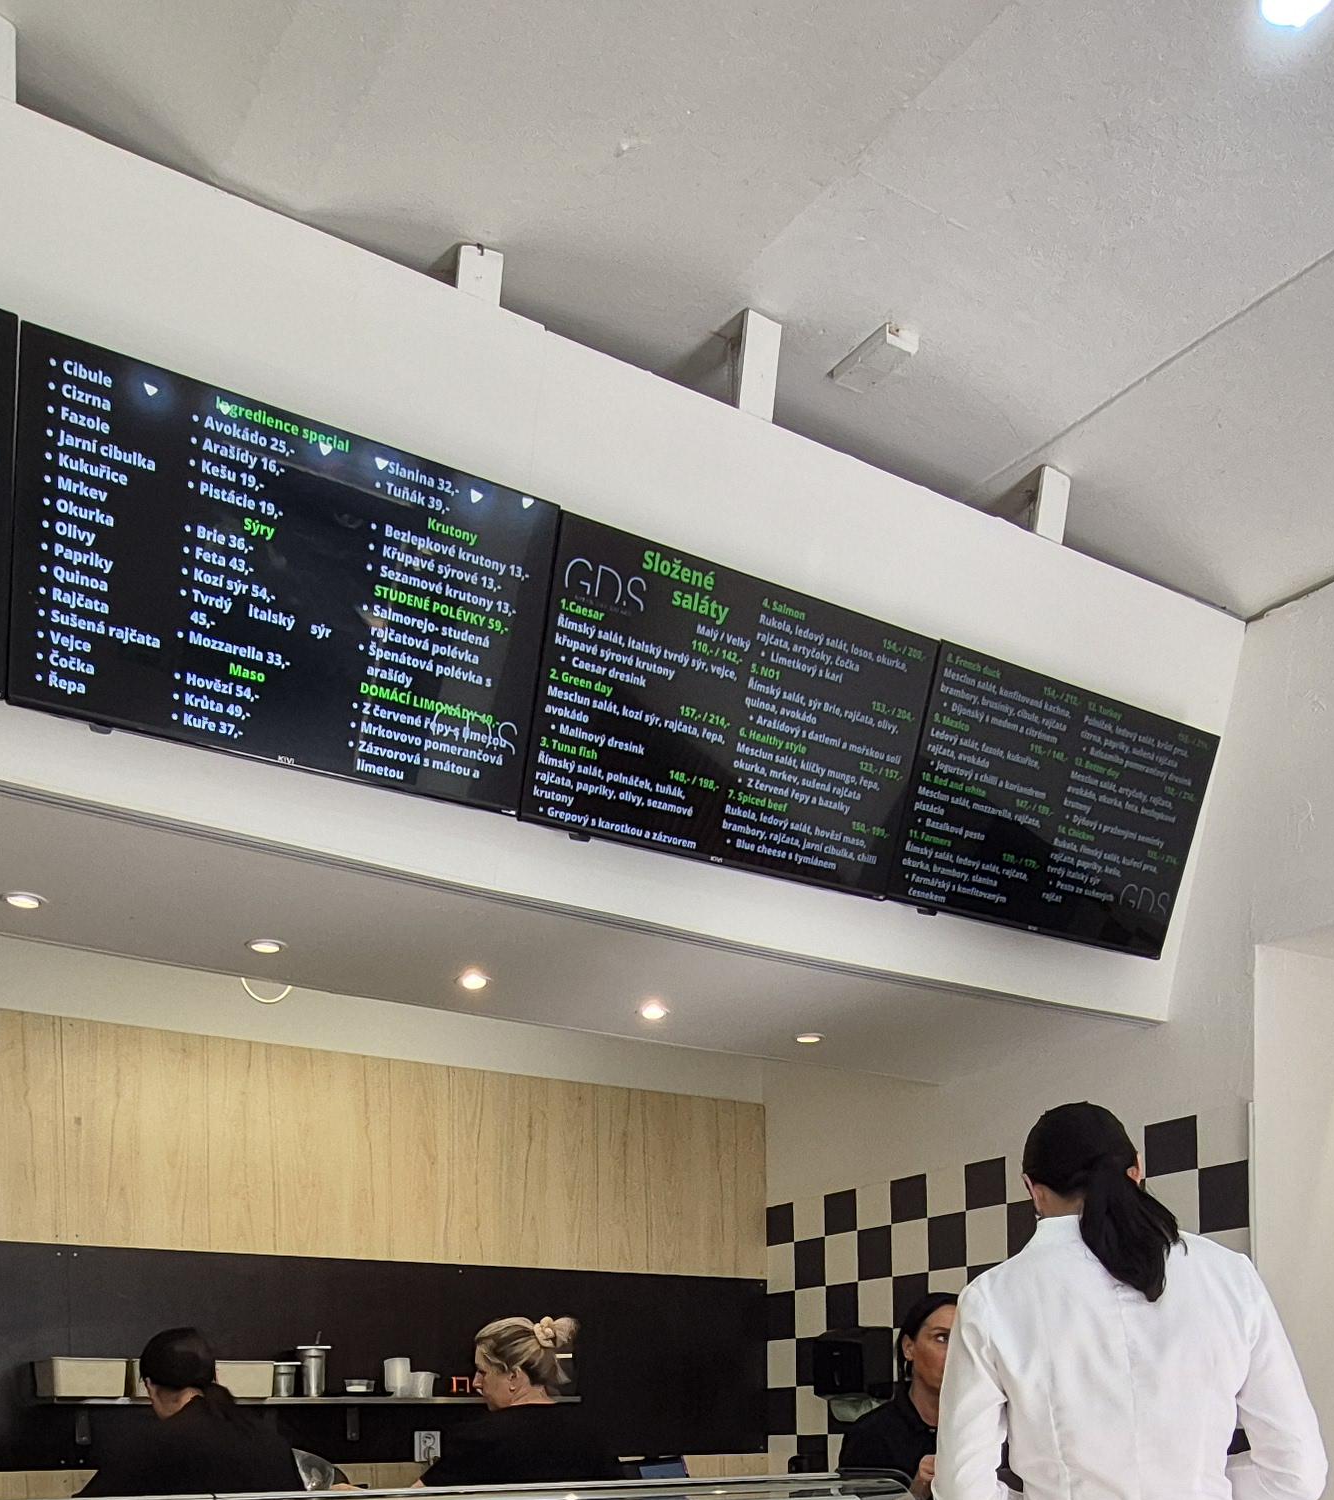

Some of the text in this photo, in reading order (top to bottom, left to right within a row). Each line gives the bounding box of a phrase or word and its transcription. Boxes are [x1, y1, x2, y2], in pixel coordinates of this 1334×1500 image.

[62, 360, 113, 388] Cibule
[61, 383, 112, 412] Cizrna
[60, 406, 111, 434] Fazole
[57, 429, 156, 472] Jarní cibulka
[203, 415, 295, 458] Avokádo 25,-
[58, 452, 128, 486] Kukuřice
[201, 437, 285, 477] Arašídy 16,-
[57, 475, 108, 502] Mrkev
[201, 458, 265, 492] Kešu 19,-
[387, 458, 460, 497] Slanina 32,-
[199, 480, 284, 520] Pistácie 19,-
[385, 480, 451, 515] Tuňák 39,-
[55, 498, 115, 528] Okurka
[55, 520, 97, 547] Olivy
[196, 524, 254, 554] Brie 36,-
[243, 517, 275, 541] Sýry
[427, 516, 478, 546] Krutony
[53, 542, 114, 574] Papriky
[195, 546, 255, 576] Feta 43,-
[52, 565, 109, 592] Quinoa
[51, 586, 109, 614] Rajčata
[373, 584, 509, 635] STUDENÉ POLÉVKY 59,-
[49, 630, 92, 653] Vejce
[50, 608, 161, 649] Sušená rajčata
[48, 648, 95, 676] Čočka
[188, 630, 291, 670] Mozzarella 33,-
[48, 670, 86, 695] Řepa
[185, 671, 260, 703] Hovězí 54,-
[229, 662, 266, 683] Maso
[366, 665, 413, 689] arašídy
[184, 692, 251, 721] Krůta 49,-
[183, 712, 244, 739] Kuře 37,-
[355, 757, 405, 780] limetou
